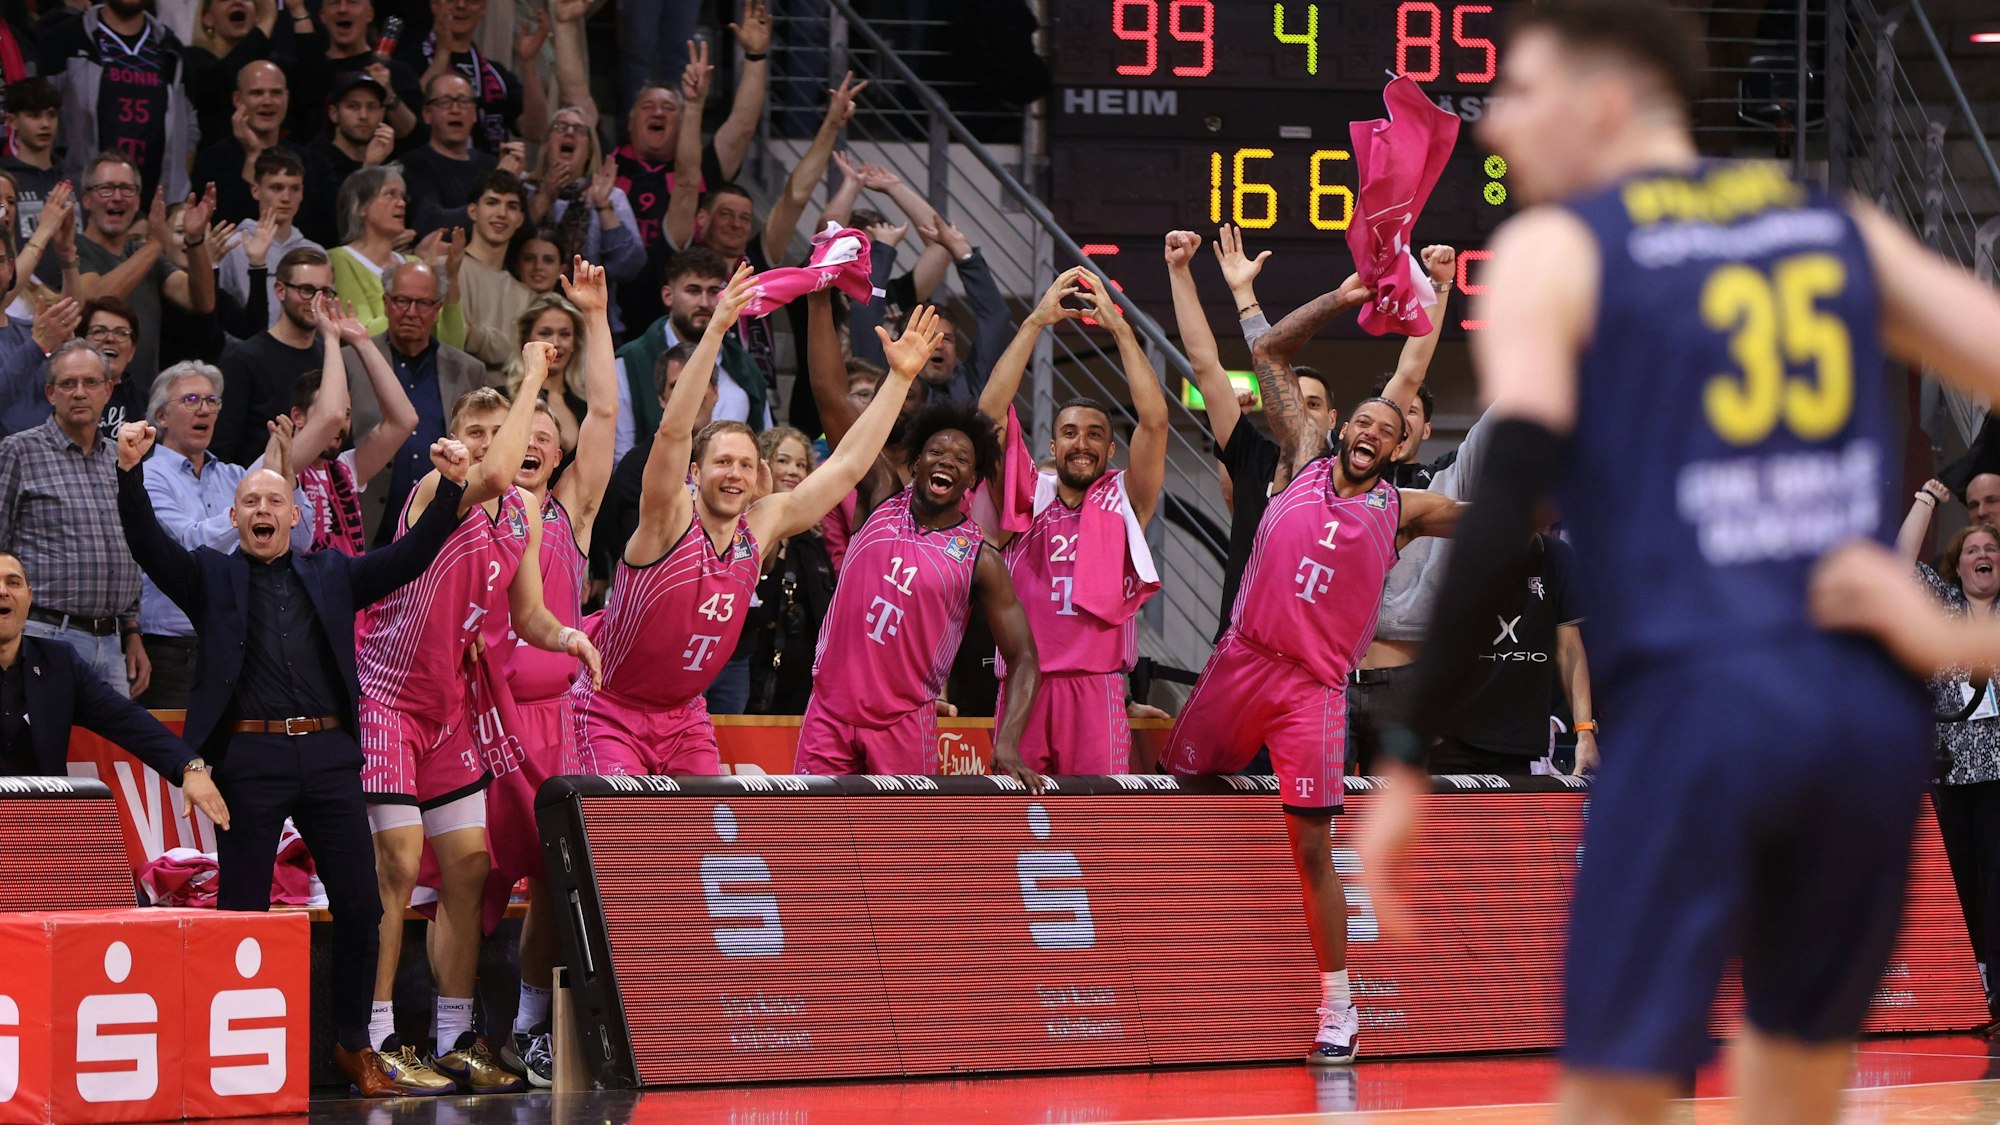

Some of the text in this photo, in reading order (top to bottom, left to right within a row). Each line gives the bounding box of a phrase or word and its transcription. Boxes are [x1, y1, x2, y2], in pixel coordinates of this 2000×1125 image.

[1112, 0, 1214, 77] 99
[1273, 3, 1318, 75] 4
[1396, 2, 1496, 83] 85
[109, 67, 159, 87] BONN
[118, 98, 149, 124] 35
[1064, 88, 1178, 115] HEIM
[639, 192, 656, 212] 9
[1702, 251, 1854, 446] 35
[1318, 520, 1340, 550] 1
[883, 556, 919, 596] 11
[698, 593, 735, 622] 43
[937, 732, 986, 776] Früh
